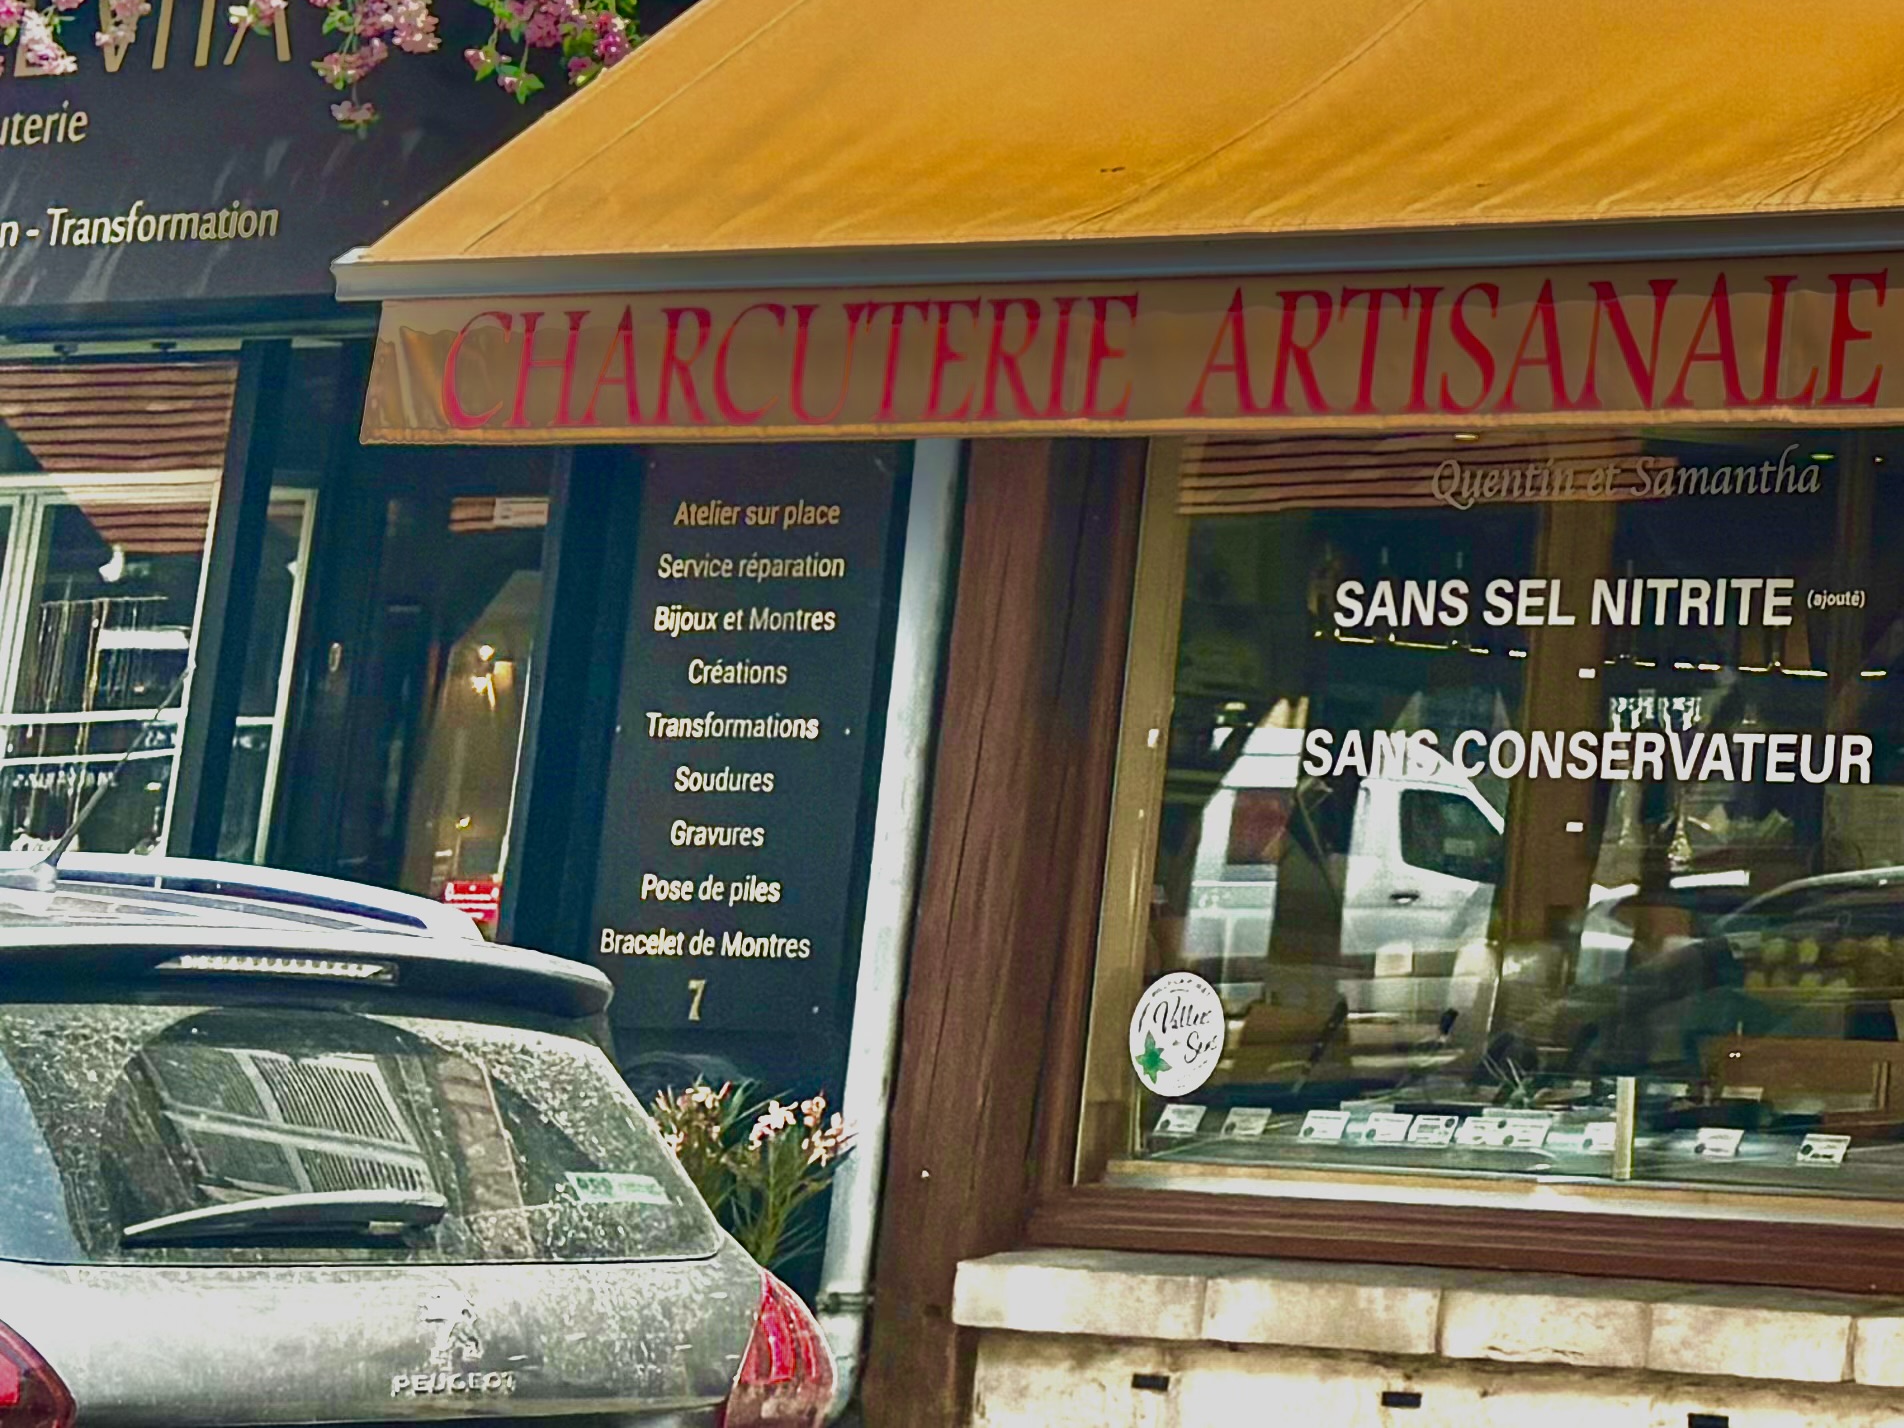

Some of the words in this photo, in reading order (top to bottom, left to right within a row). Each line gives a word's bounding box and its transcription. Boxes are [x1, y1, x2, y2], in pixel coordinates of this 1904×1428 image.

[47, 200, 279, 246] Transformation
[441, 291, 1140, 429] CHARCUTERIE
[1186, 267, 1888, 417] ARTISANALE
[1431, 458, 1577, 511] Quentin
[1586, 467, 1622, 498] et
[1630, 443, 1822, 499] Samantha
[673, 500, 741, 526] Atelier
[745, 505, 779, 526] sur
[783, 499, 841, 531] place
[658, 552, 733, 579] Service
[739, 551, 846, 583] réparation
[1334, 580, 1470, 628] SANS
[1483, 579, 1575, 627] SEL
[1590, 578, 1795, 627] NITRITE
[1807, 589, 1866, 610] (ajouté)
[654, 604, 719, 638] Bijoux
[723, 609, 743, 632] et
[750, 607, 837, 632] Montres
[688, 657, 789, 685] Créations
[646, 710, 820, 740] Transformations
[1303, 729, 1441, 778] SANS
[1453, 729, 1875, 785] CONSERVATEUR
[674, 765, 776, 793] Soudures
[670, 819, 766, 847] Gravures
[640, 872, 694, 902] Pose
[698, 873, 724, 902] de
[729, 874, 782, 908] piles
[600, 928, 685, 956] Bracelet
[689, 928, 716, 957] de
[721, 930, 812, 959] Montres
[688, 978, 707, 1022] 7
[390, 1371, 517, 1398] PEUGEOT
